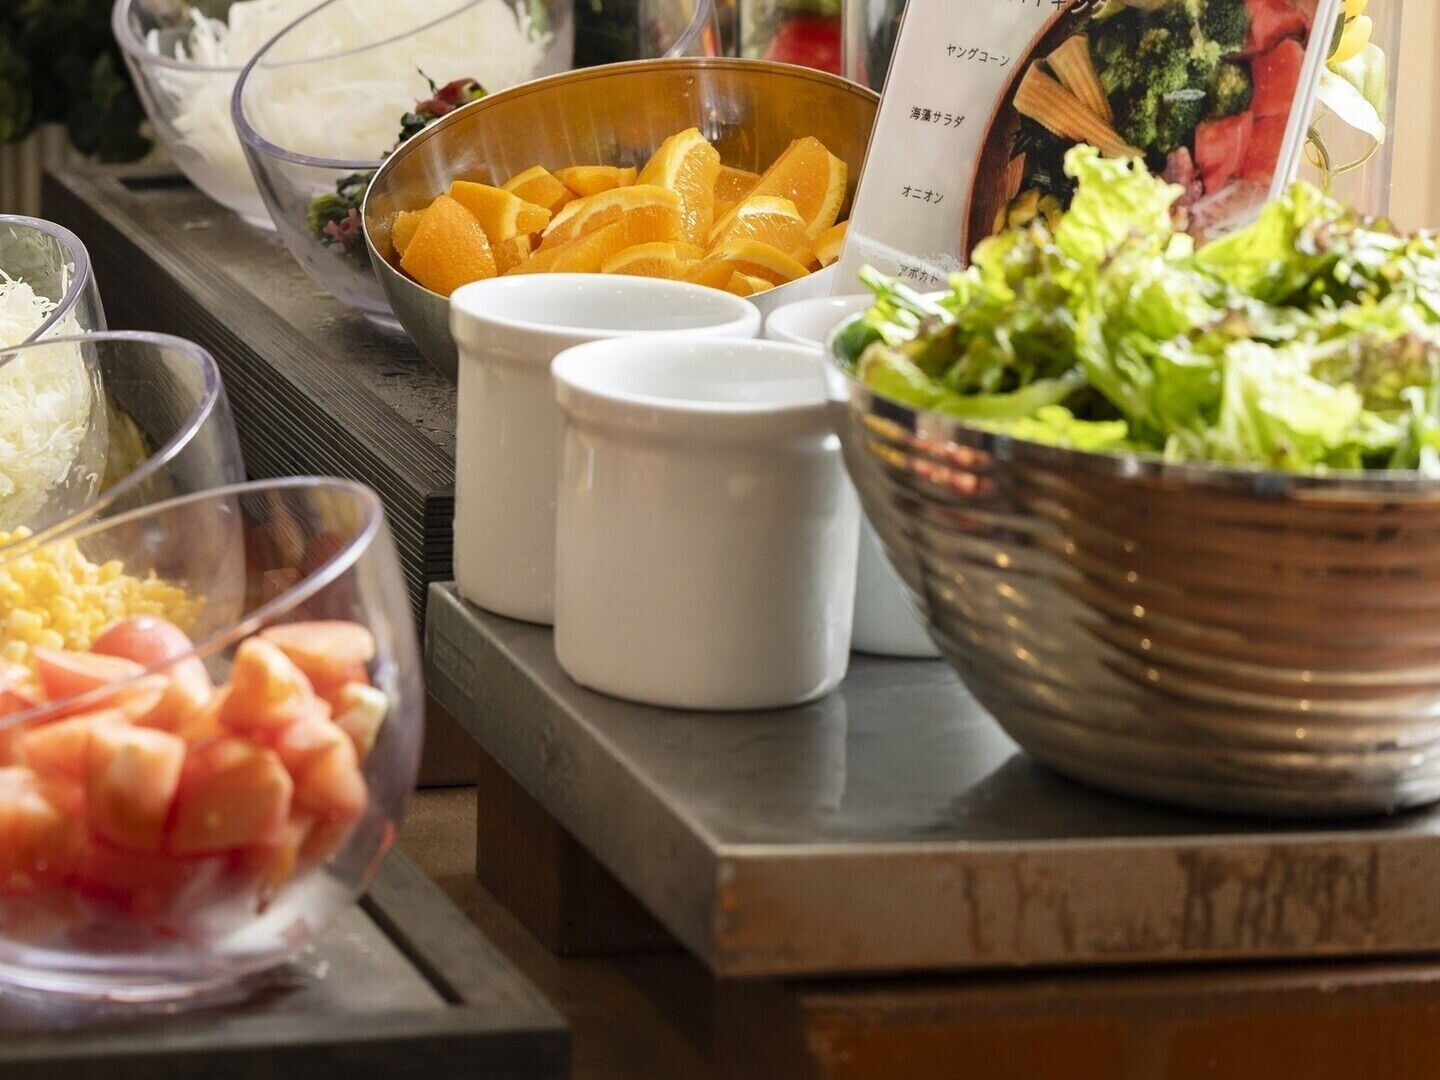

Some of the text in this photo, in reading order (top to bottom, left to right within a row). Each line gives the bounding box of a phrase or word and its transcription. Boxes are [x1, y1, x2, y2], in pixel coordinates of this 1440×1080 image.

[946, 43, 1011, 67] ヤングコーン
[909, 106, 965, 128] 海藻サラダ
[901, 185, 944, 204] オニオン
